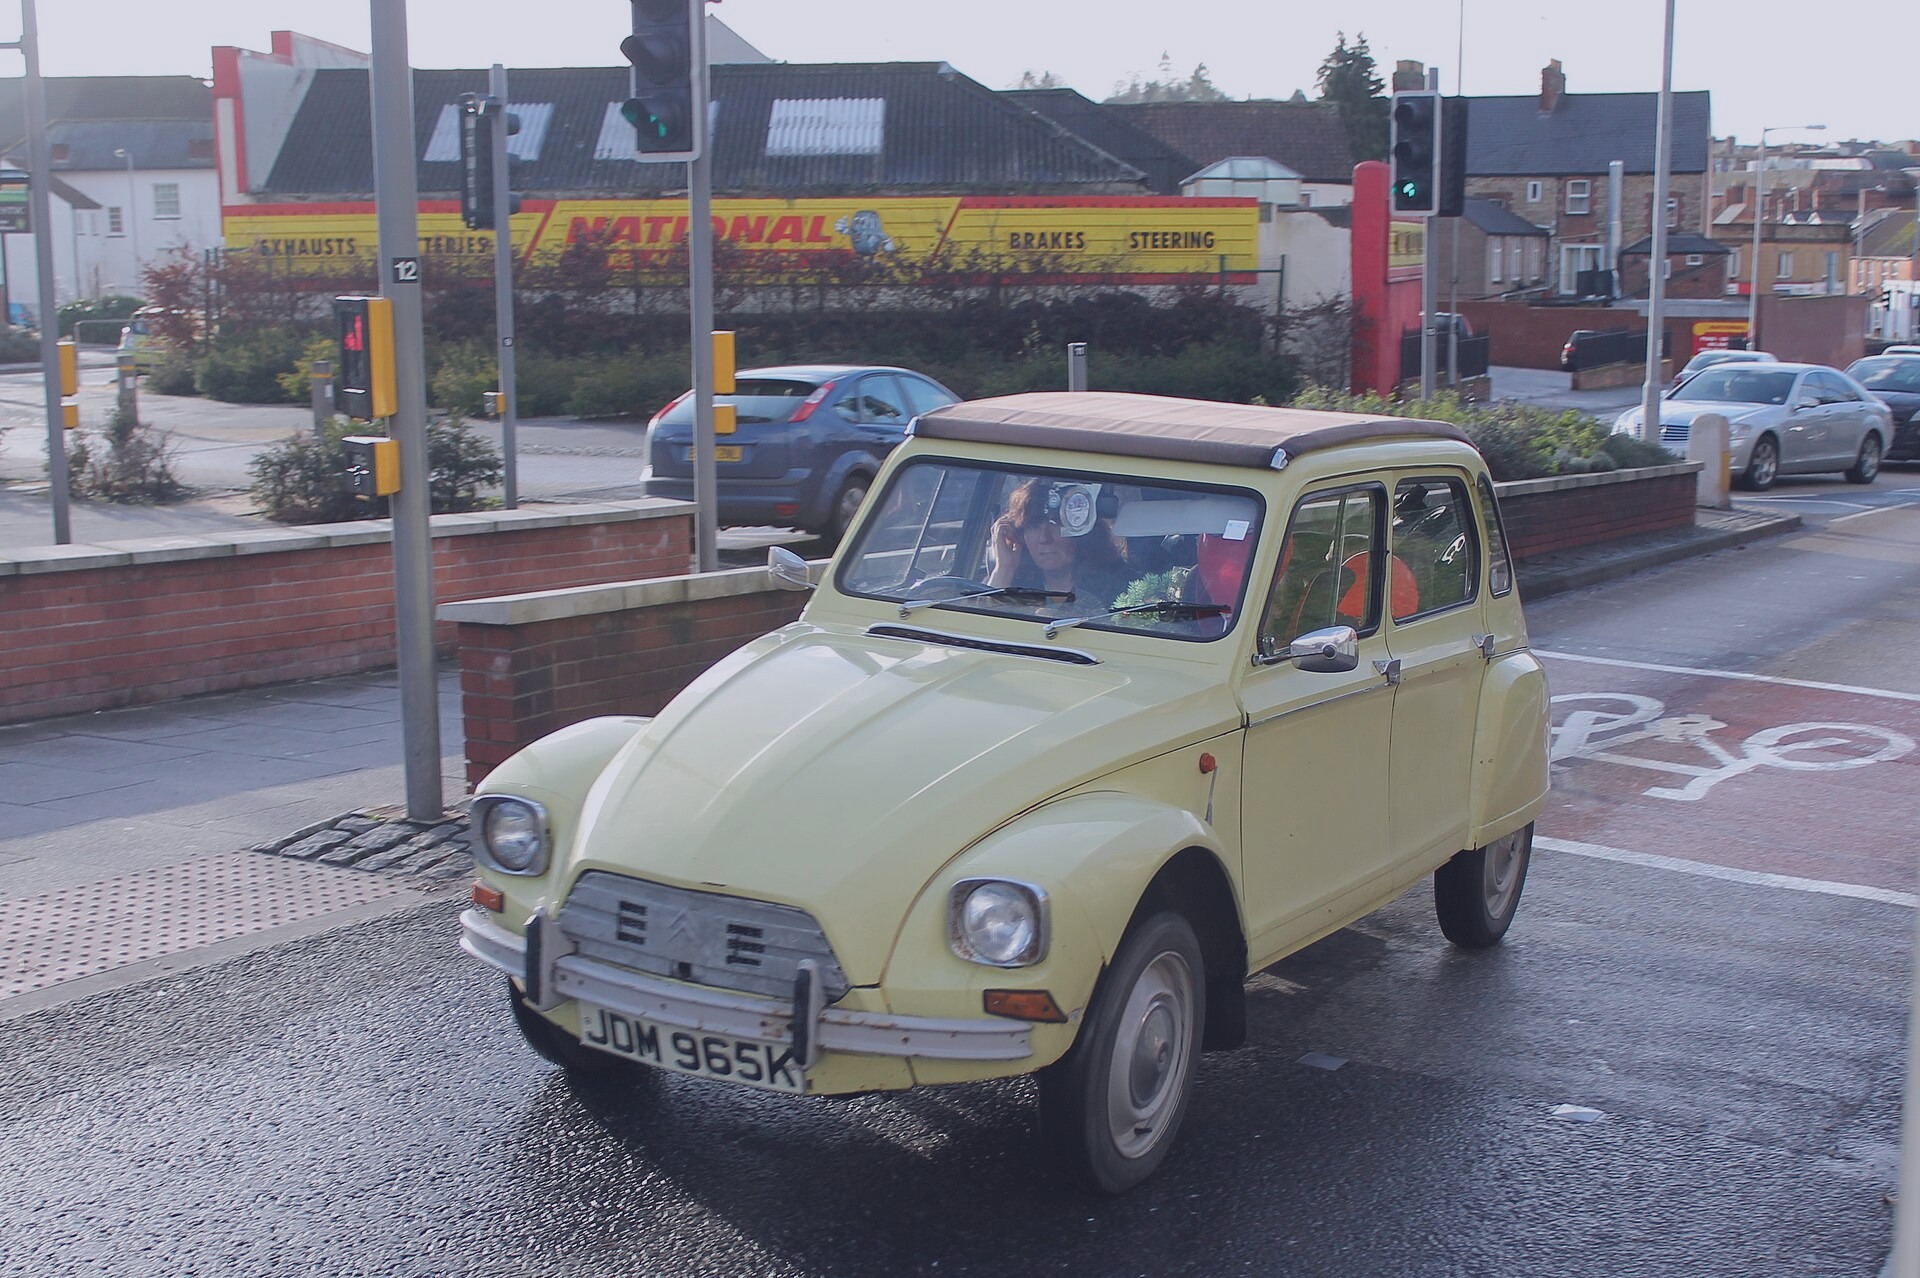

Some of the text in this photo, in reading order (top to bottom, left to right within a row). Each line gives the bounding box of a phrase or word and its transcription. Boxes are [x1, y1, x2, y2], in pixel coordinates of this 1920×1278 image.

[259, 237, 356, 257] EXHAUSTS
[417, 236, 489, 255] TERIES
[1009, 231, 1085, 250] BRAKES
[1129, 231, 1215, 250] STEERING
[393, 260, 418, 281] 12
[588, 1008, 797, 1088] JDM 965K
